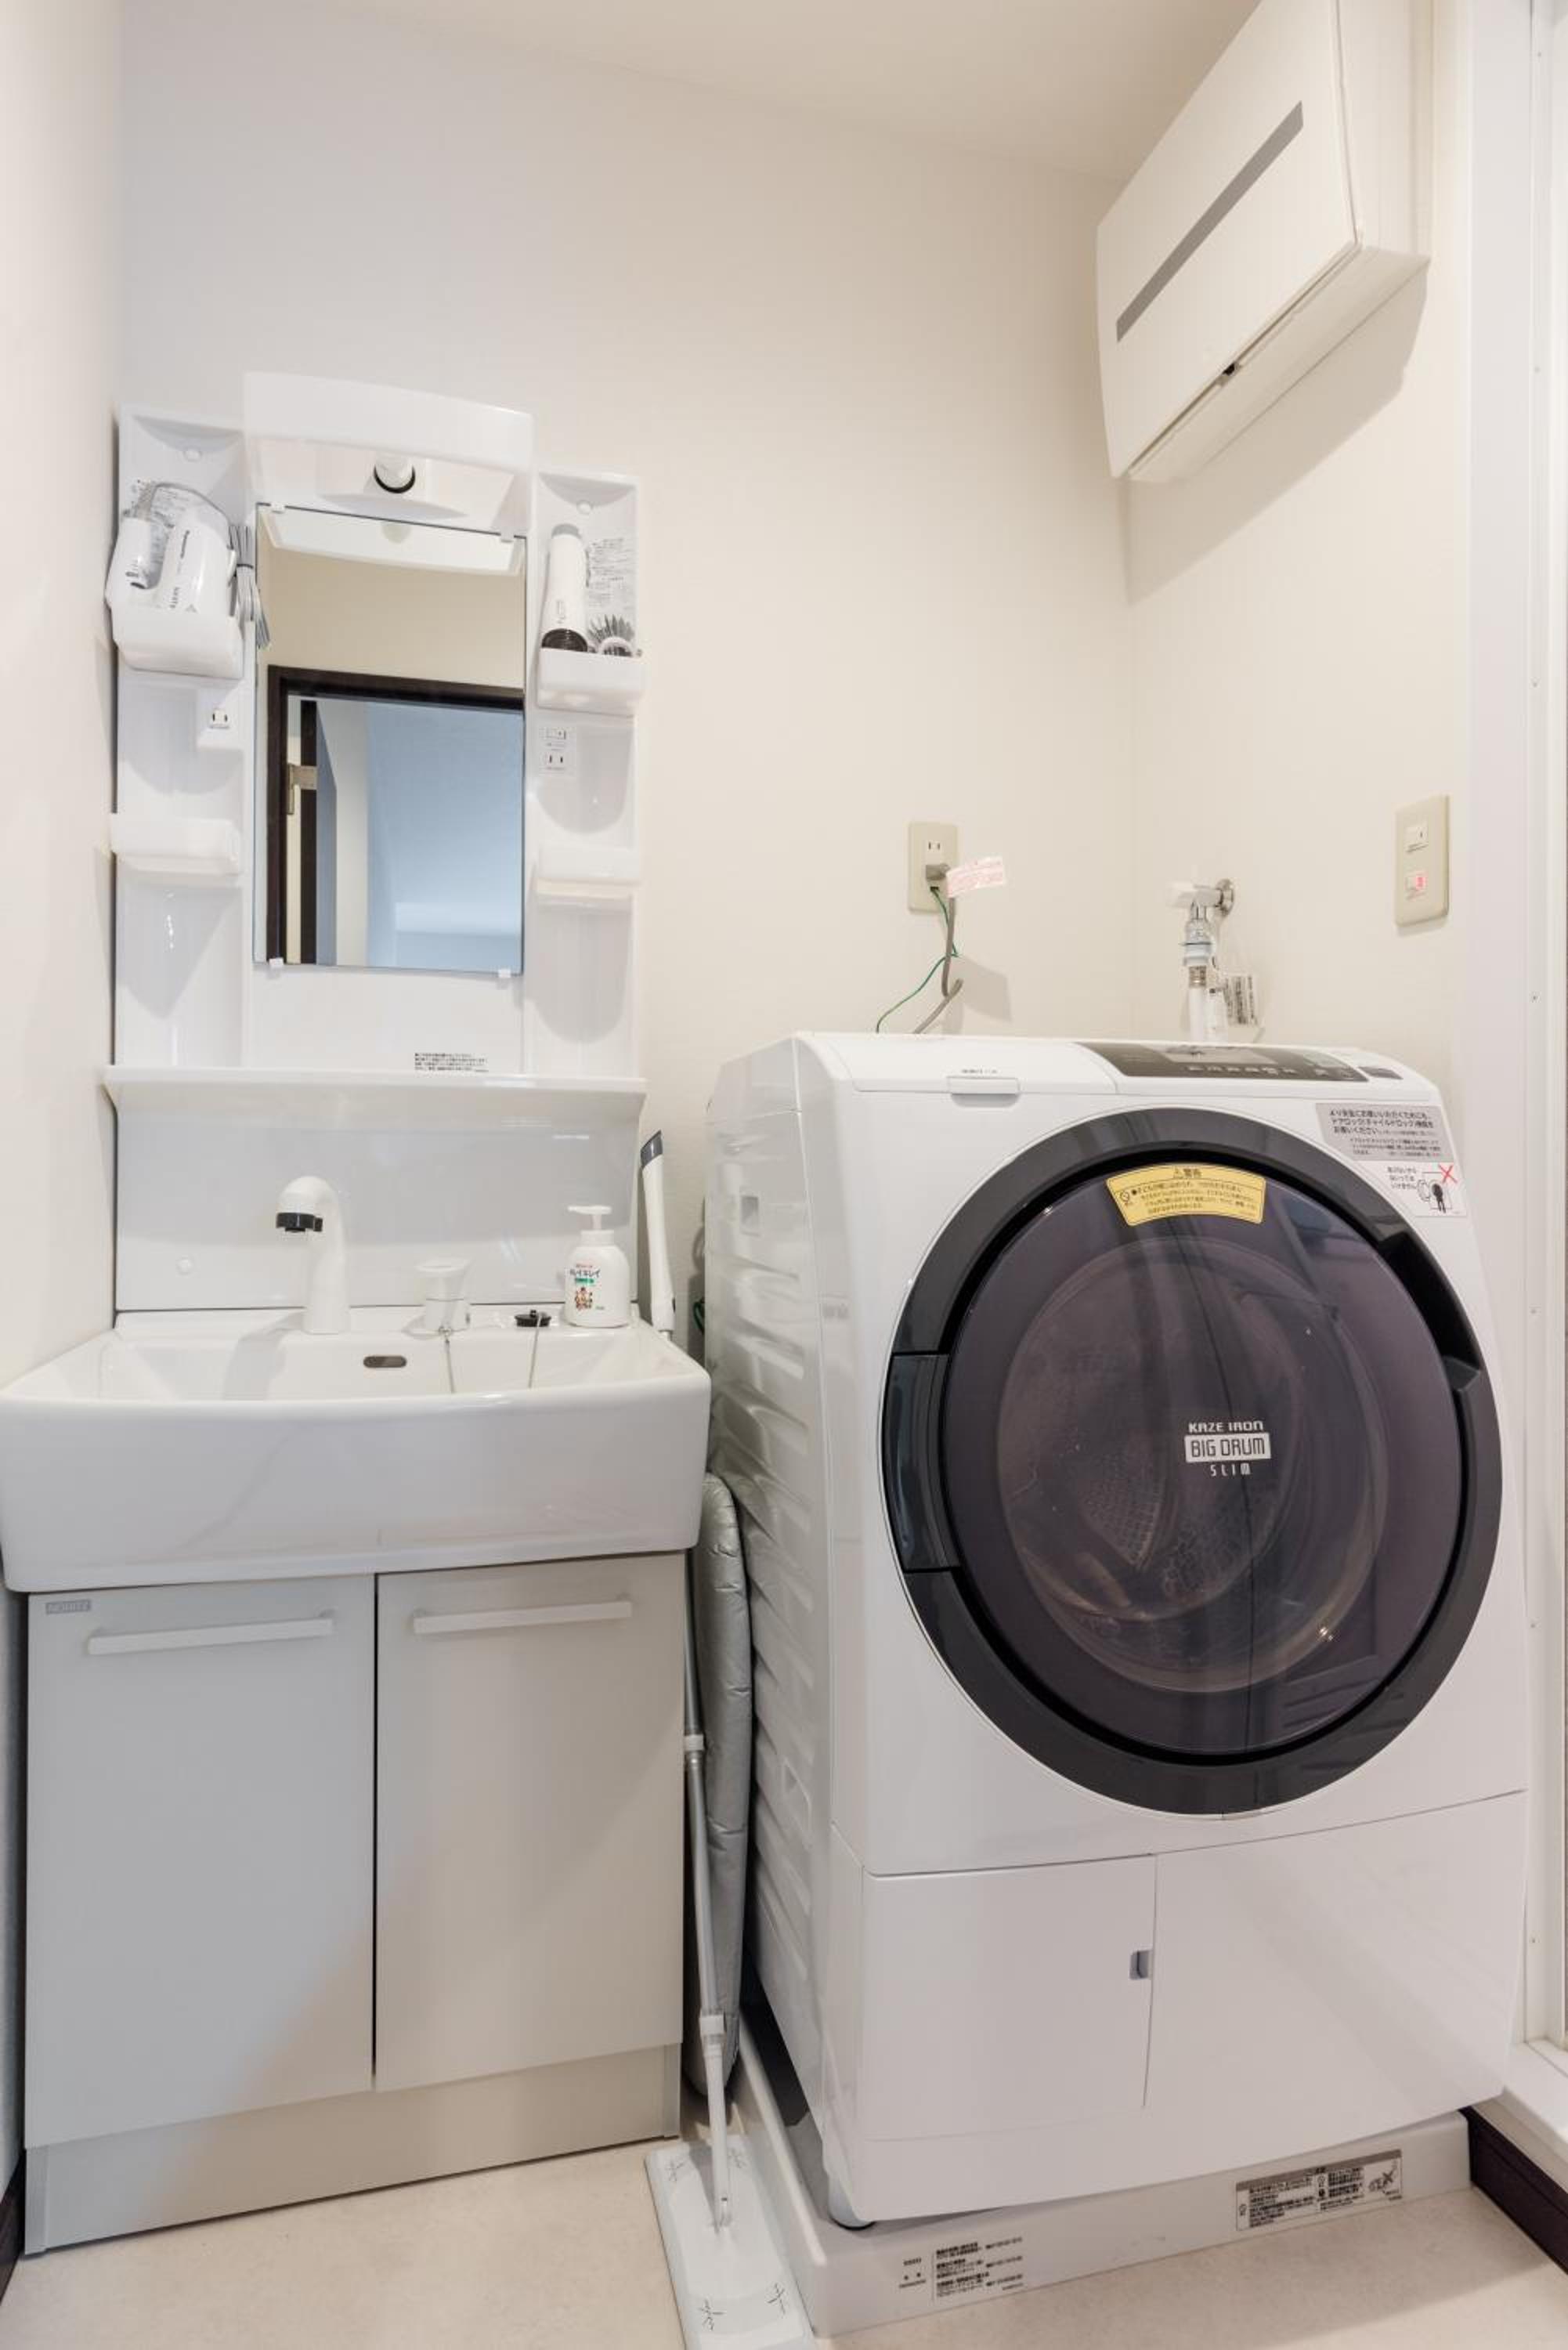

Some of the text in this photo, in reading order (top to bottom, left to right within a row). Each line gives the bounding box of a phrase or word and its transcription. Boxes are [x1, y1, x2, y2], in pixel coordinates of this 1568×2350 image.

[1188, 1420, 1264, 1433] KAZE IRON
[1191, 1437, 1266, 1458] BIG DRUM
[1210, 1462, 1252, 1477] SLIM
